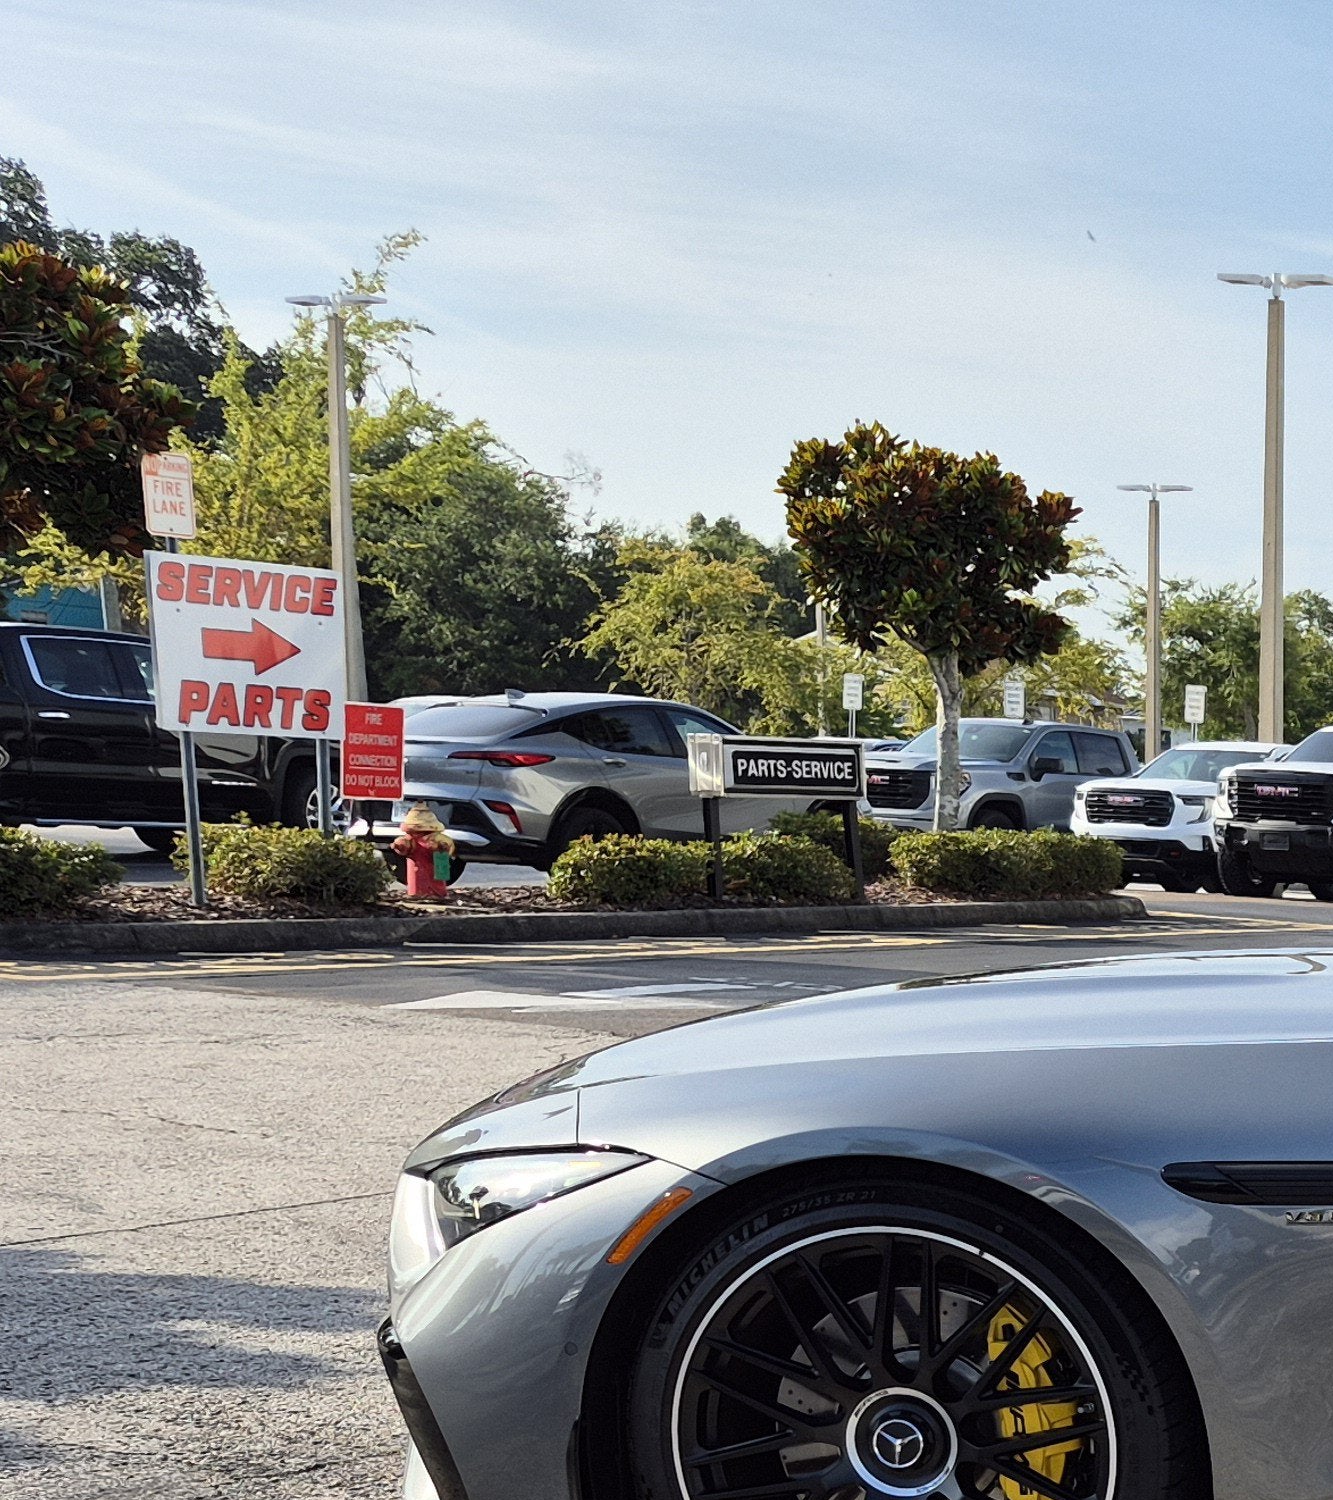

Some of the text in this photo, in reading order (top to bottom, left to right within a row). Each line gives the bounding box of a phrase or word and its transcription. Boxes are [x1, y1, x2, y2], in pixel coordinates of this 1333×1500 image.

[152, 478, 183, 498] FIRE
[152, 498, 187, 517] LANE
[156, 561, 338, 617] SERVICE
[178, 679, 332, 732] PARTS
[364, 713, 383, 725] FIRE
[348, 733, 399, 747] DEPARTMENT
[348, 753, 398, 767] CONNECTION
[737, 758, 854, 780] PARTS-SERVICE
[345, 774, 400, 788] DO NOT BLOCK
[666, 1213, 770, 1318] MICHELIN
